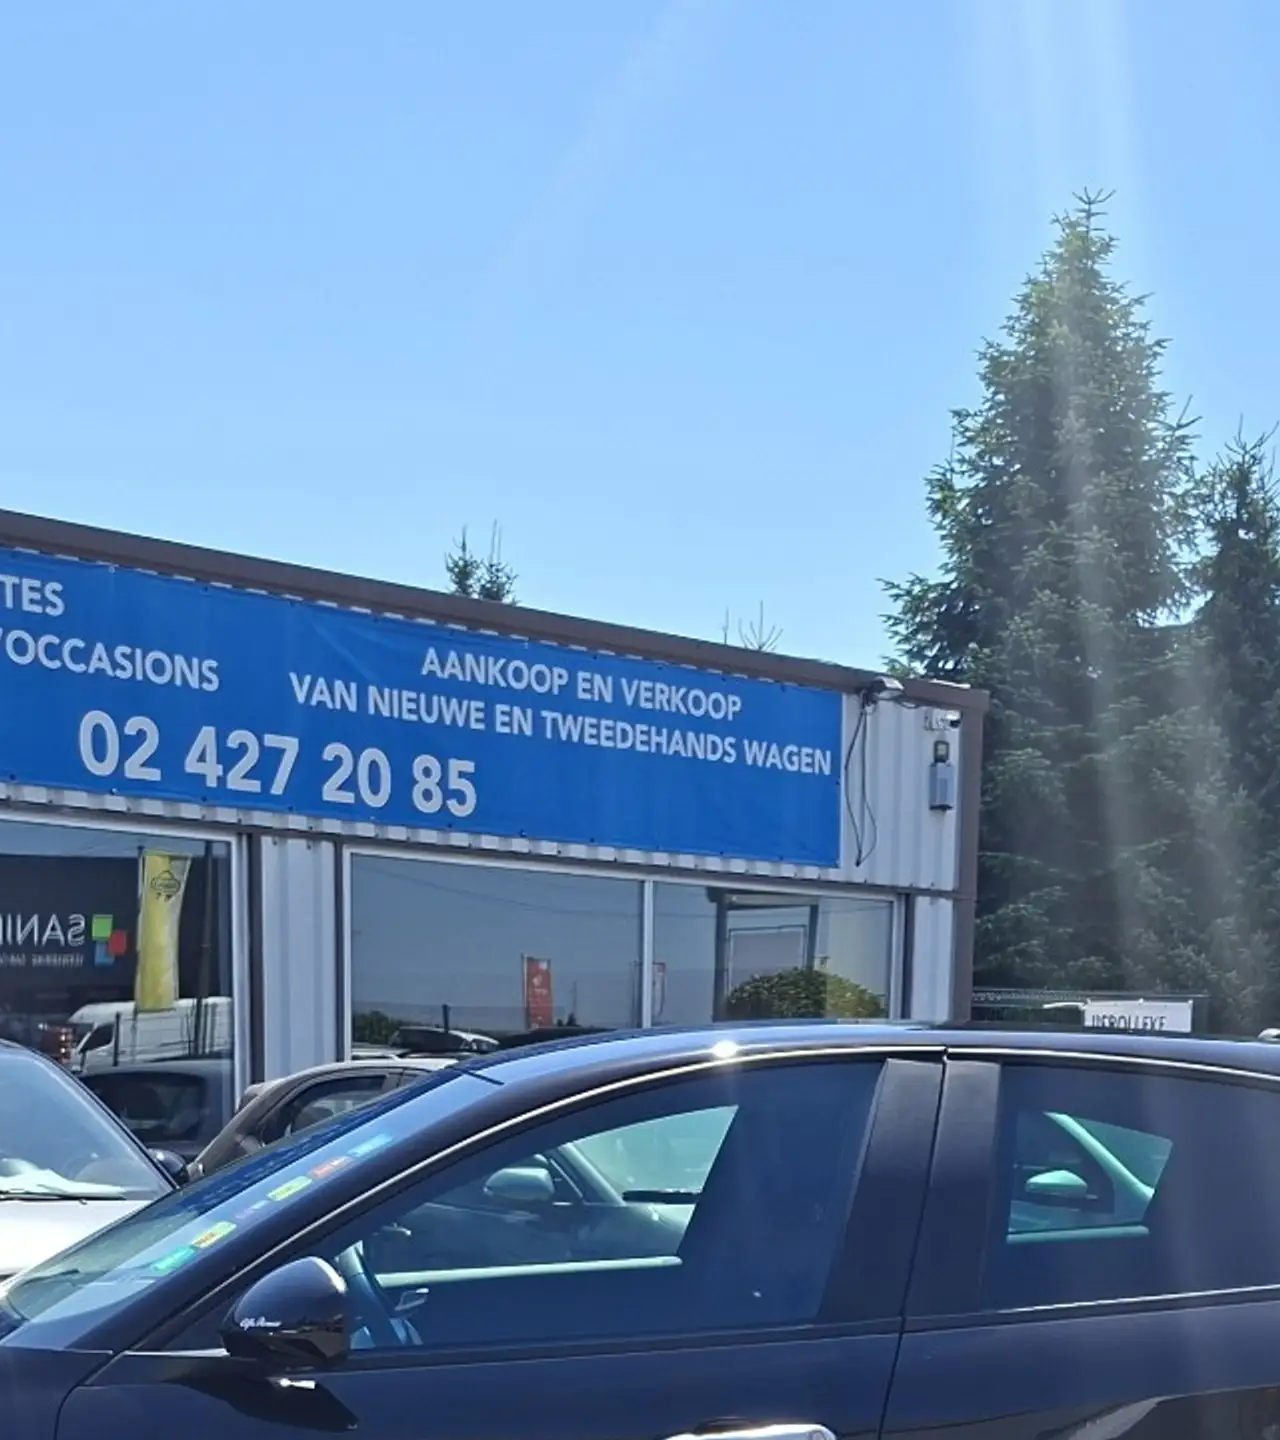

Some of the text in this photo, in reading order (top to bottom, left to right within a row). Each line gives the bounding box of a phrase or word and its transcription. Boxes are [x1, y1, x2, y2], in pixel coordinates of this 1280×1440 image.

[290, 673, 831, 775] VAN NIEUWE EN TWEEDEHANDS WAGEN
[422, 648, 741, 721] AANKOOP EN VERKOOP
[79, 710, 477, 817] 02 427 20 85
